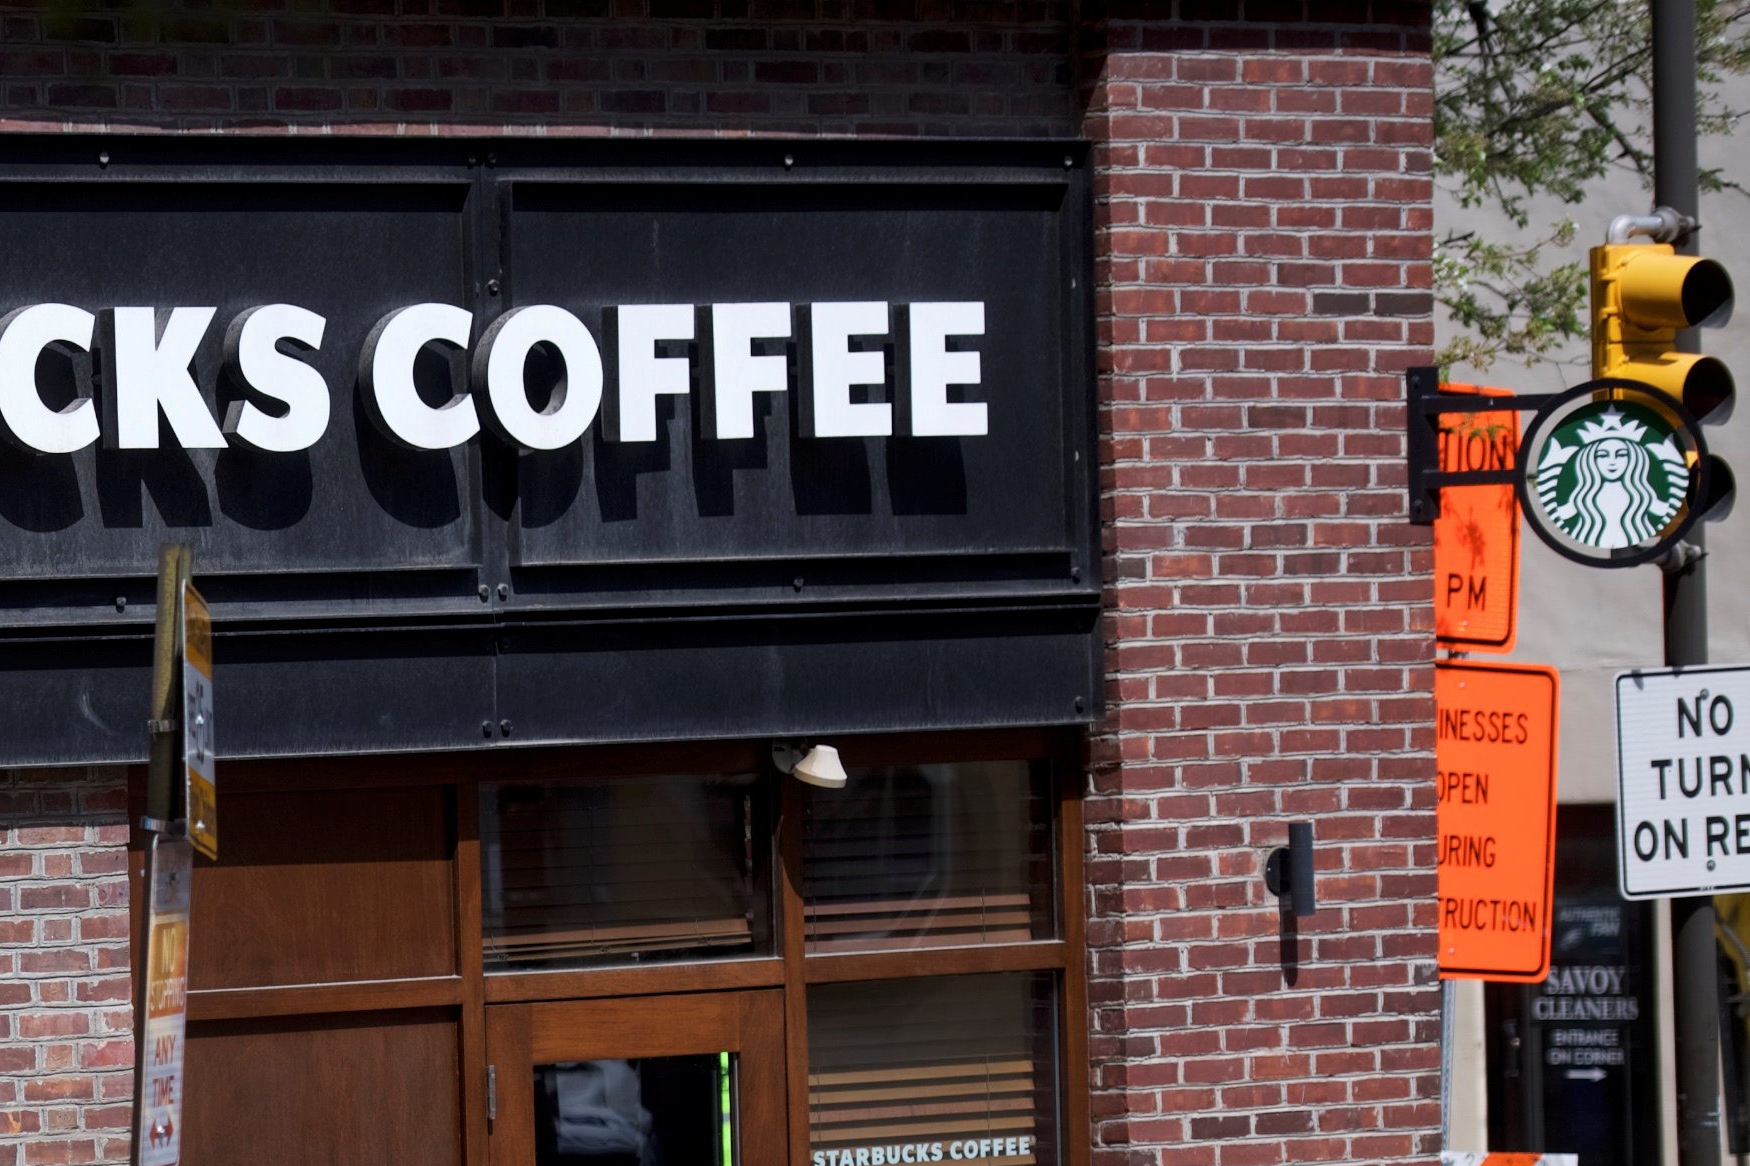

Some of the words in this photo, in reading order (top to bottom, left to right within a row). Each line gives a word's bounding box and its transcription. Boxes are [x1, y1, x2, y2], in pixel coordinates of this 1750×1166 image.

[371, 300, 989, 451] COFFEE
[1447, 573, 1487, 612] PM
[1439, 707, 1529, 745] INESSES
[1677, 694, 1734, 738] NO
[1634, 816, 1689, 863] ON
[1438, 897, 1537, 933] RUCTION
[1545, 964, 1626, 995] SAVOY
[1532, 996, 1639, 1021] CLEANERS
[154, 1034, 177, 1067] ANY
[1552, 1028, 1620, 1047] ENTRANCE
[1547, 1047, 1572, 1066] ON
[1574, 1047, 1625, 1066] CORNER
[153, 1074, 175, 1108] TIME
[949, 1135, 1031, 1161] COFFEE
